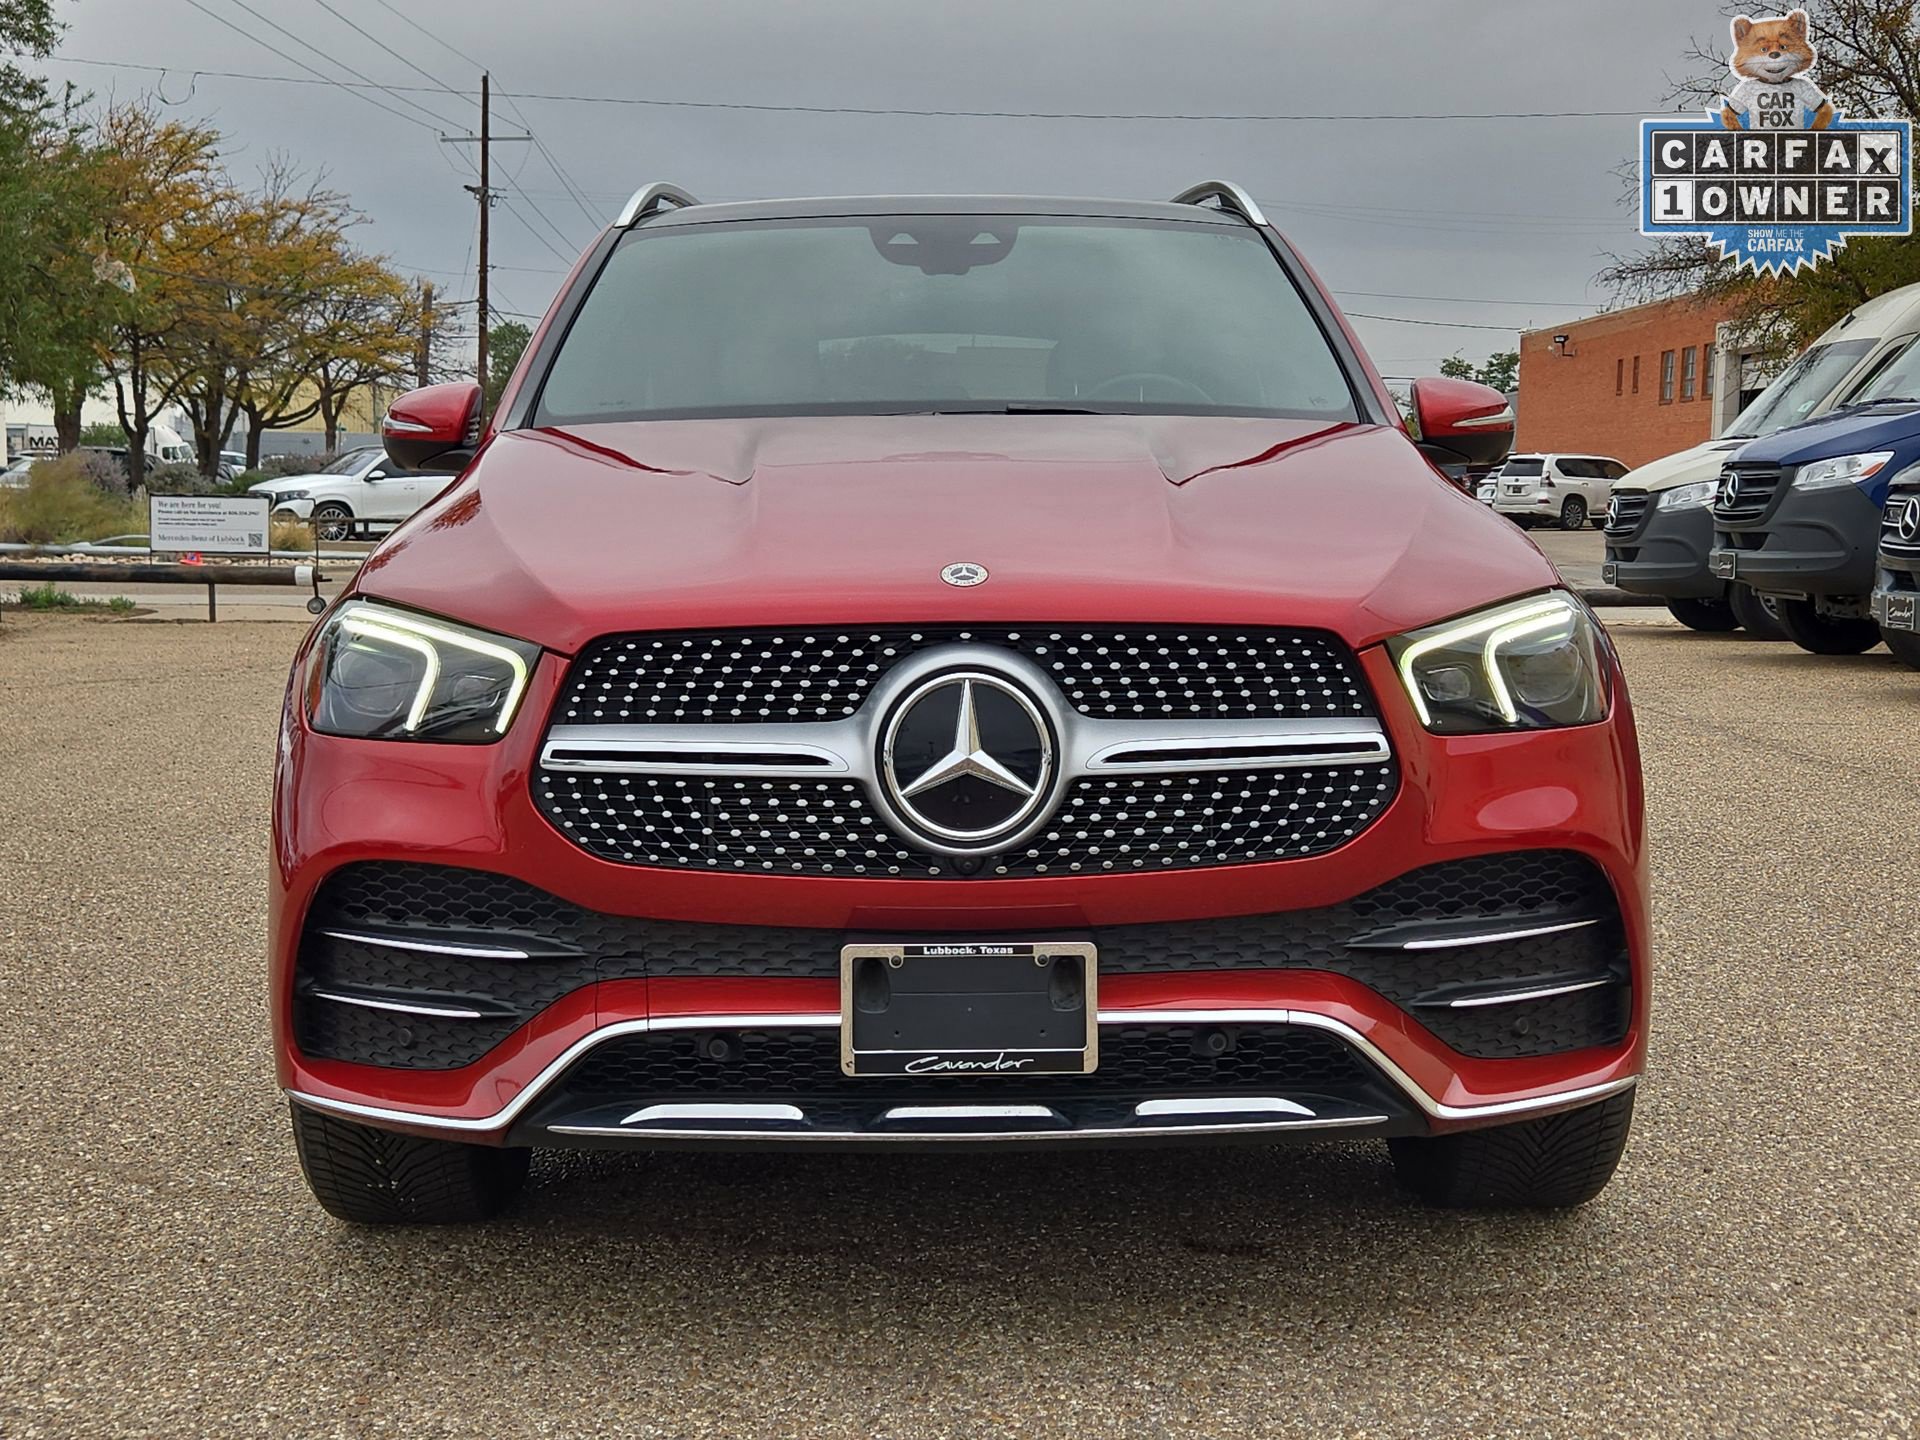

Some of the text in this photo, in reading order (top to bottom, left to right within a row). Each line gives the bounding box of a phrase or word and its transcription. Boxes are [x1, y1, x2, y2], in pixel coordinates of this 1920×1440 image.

[158, 500, 168, 508] We
[181, 500, 195, 508] here
[198, 500, 206, 508] for
[217, 535, 244, 543] Lubbock
[980, 945, 1014, 954] Texas
[904, 1052, 1034, 1073] Cavender
